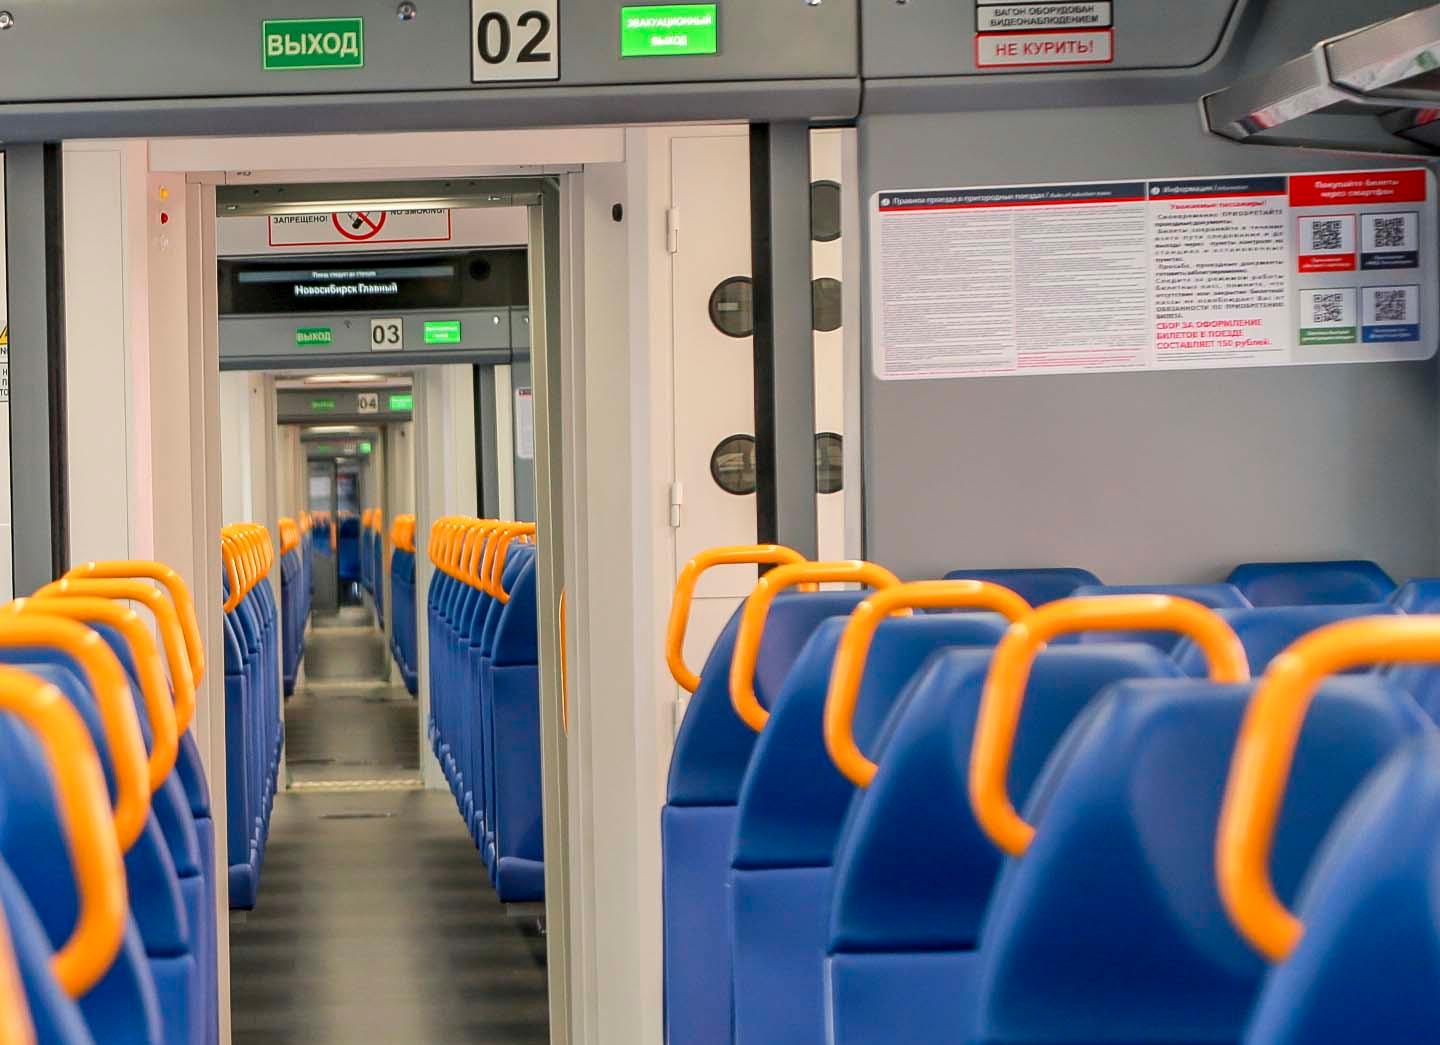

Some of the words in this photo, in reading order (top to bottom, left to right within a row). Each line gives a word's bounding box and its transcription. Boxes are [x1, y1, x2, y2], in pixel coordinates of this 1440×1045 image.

[995, 8, 1027, 16] ВАГОН
[1028, 6, 1094, 15] ОБОРУДОВАН
[990, 15, 1098, 26] ВИДЕОНАБЛЮДЕНИЕМ
[476, 10, 552, 65] 02
[267, 31, 359, 59] ВЫХОД
[996, 43, 1018, 56] НЕ
[1024, 40, 1094, 55] КУРИТЬ!
[273, 216, 328, 224] ЗАПРЕЩЕНО!
[294, 284, 358, 296] Новосибирск
[359, 282, 398, 293] Главный
[1196, 319, 1262, 328] ОФОРМЛЕНИЕ
[297, 331, 331, 342] ВЫХОД
[372, 324, 400, 344] 03
[1156, 331, 1197, 339] БИЛЕТОВ
[1156, 340, 1215, 349] СОСТАВЛЯЕТ
[359, 398, 377, 410] 04
